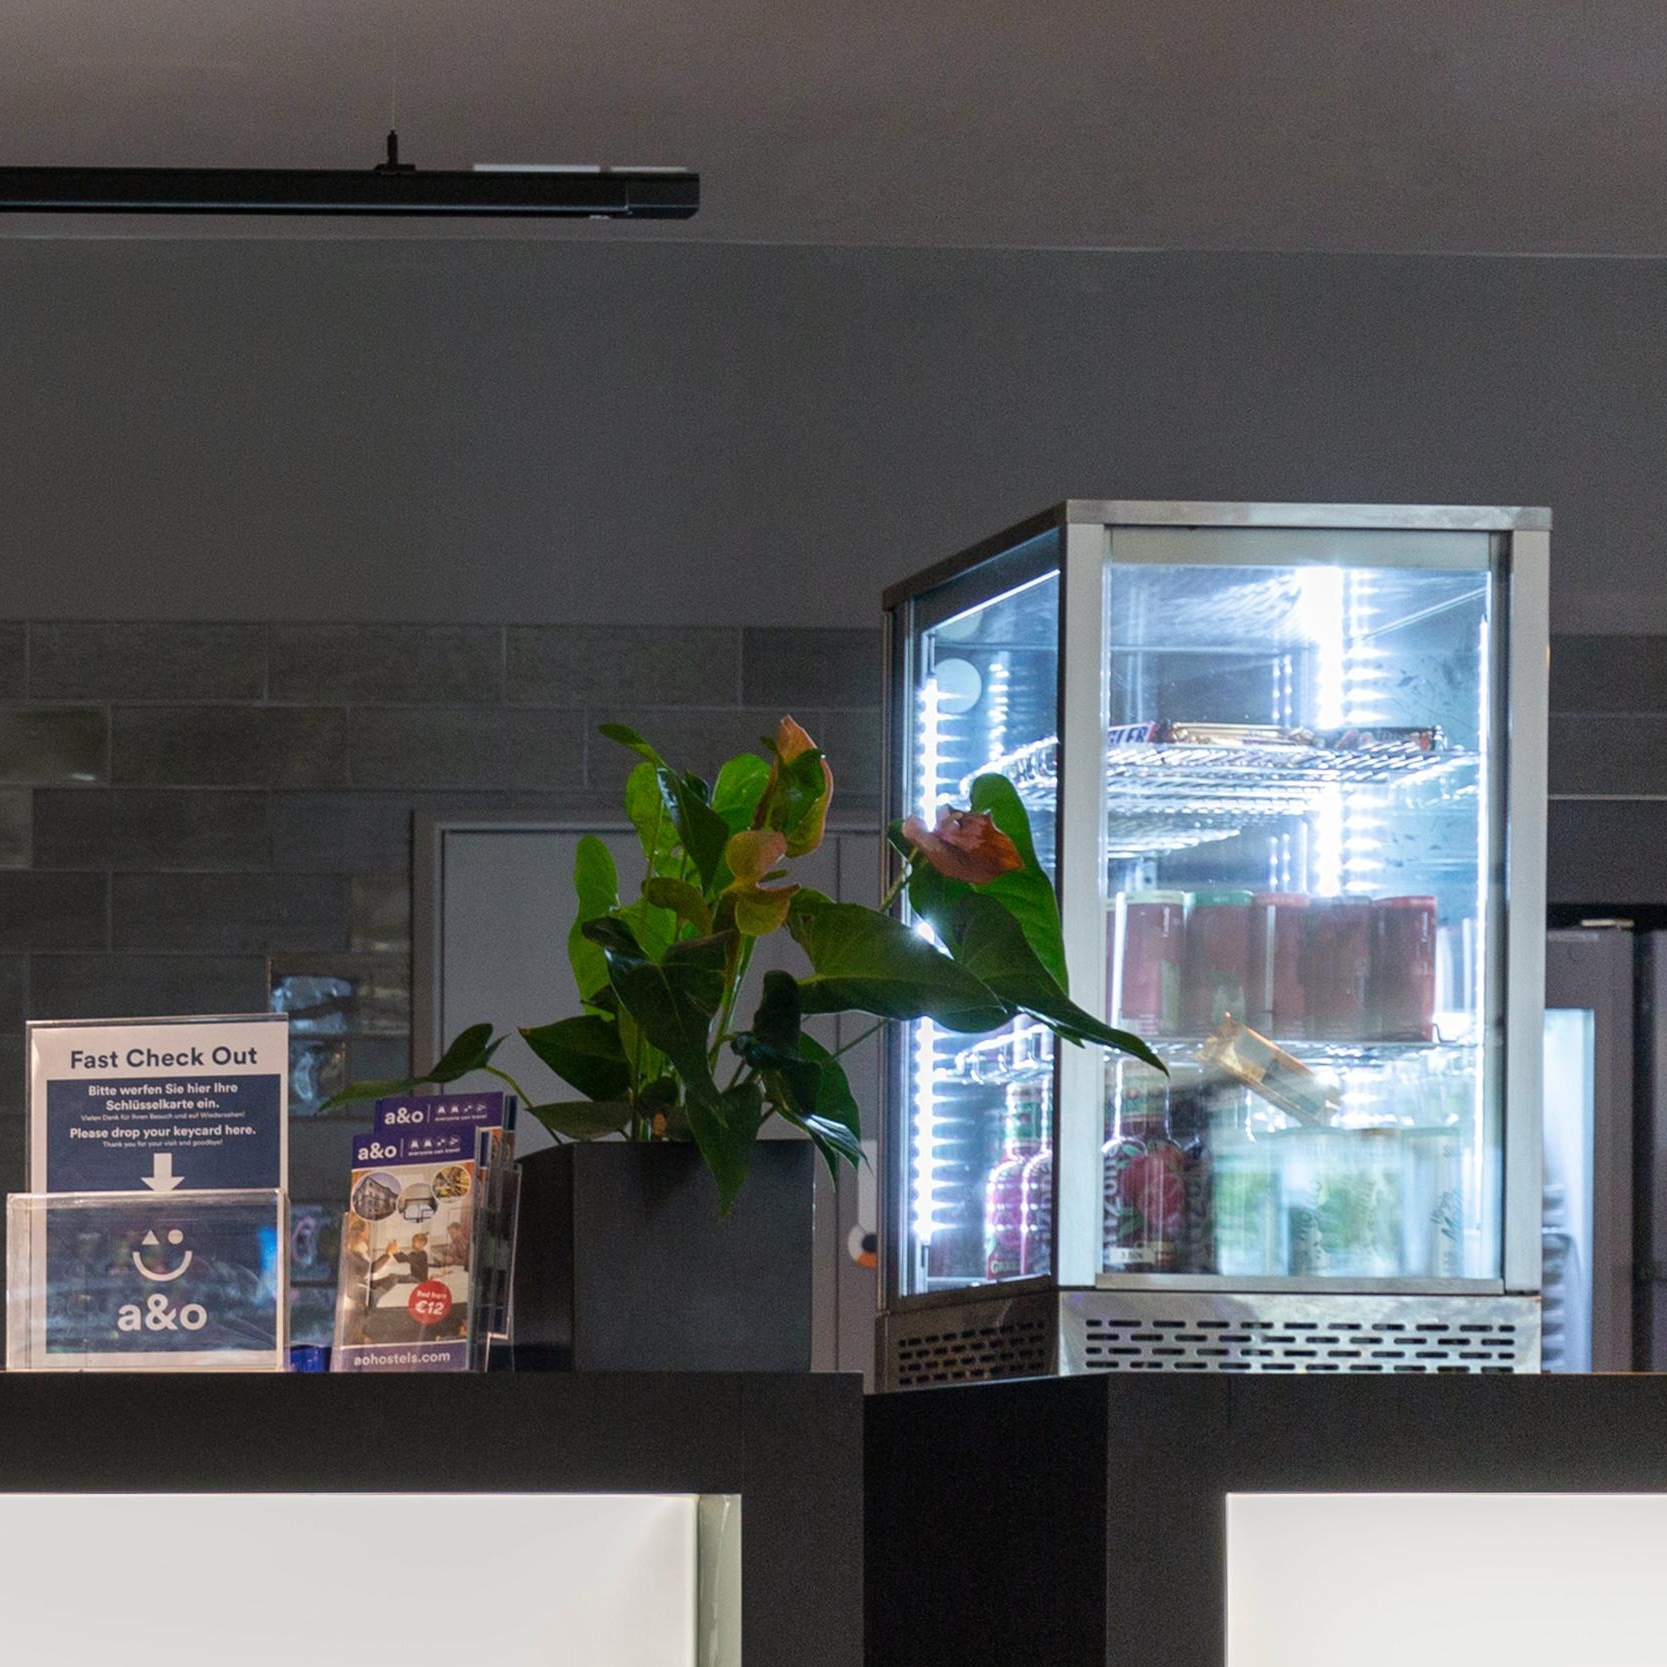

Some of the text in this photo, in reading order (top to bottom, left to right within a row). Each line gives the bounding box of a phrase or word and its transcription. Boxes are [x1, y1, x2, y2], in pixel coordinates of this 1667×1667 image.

[71, 1046, 257, 1069] Fast Check Out
[88, 1082, 238, 1097] Bitte werfen Sie hier Ihre
[106, 1097, 219, 1111] Schlüsselkarte ein.
[384, 1107, 424, 1125] a&o
[70, 1124, 256, 1141] Please drop your keycard here.
[357, 1142, 397, 1160] a&o
[117, 1294, 208, 1332] a&o
[415, 1300, 444, 1315] €12
[354, 1351, 451, 1366] aohostels.com
